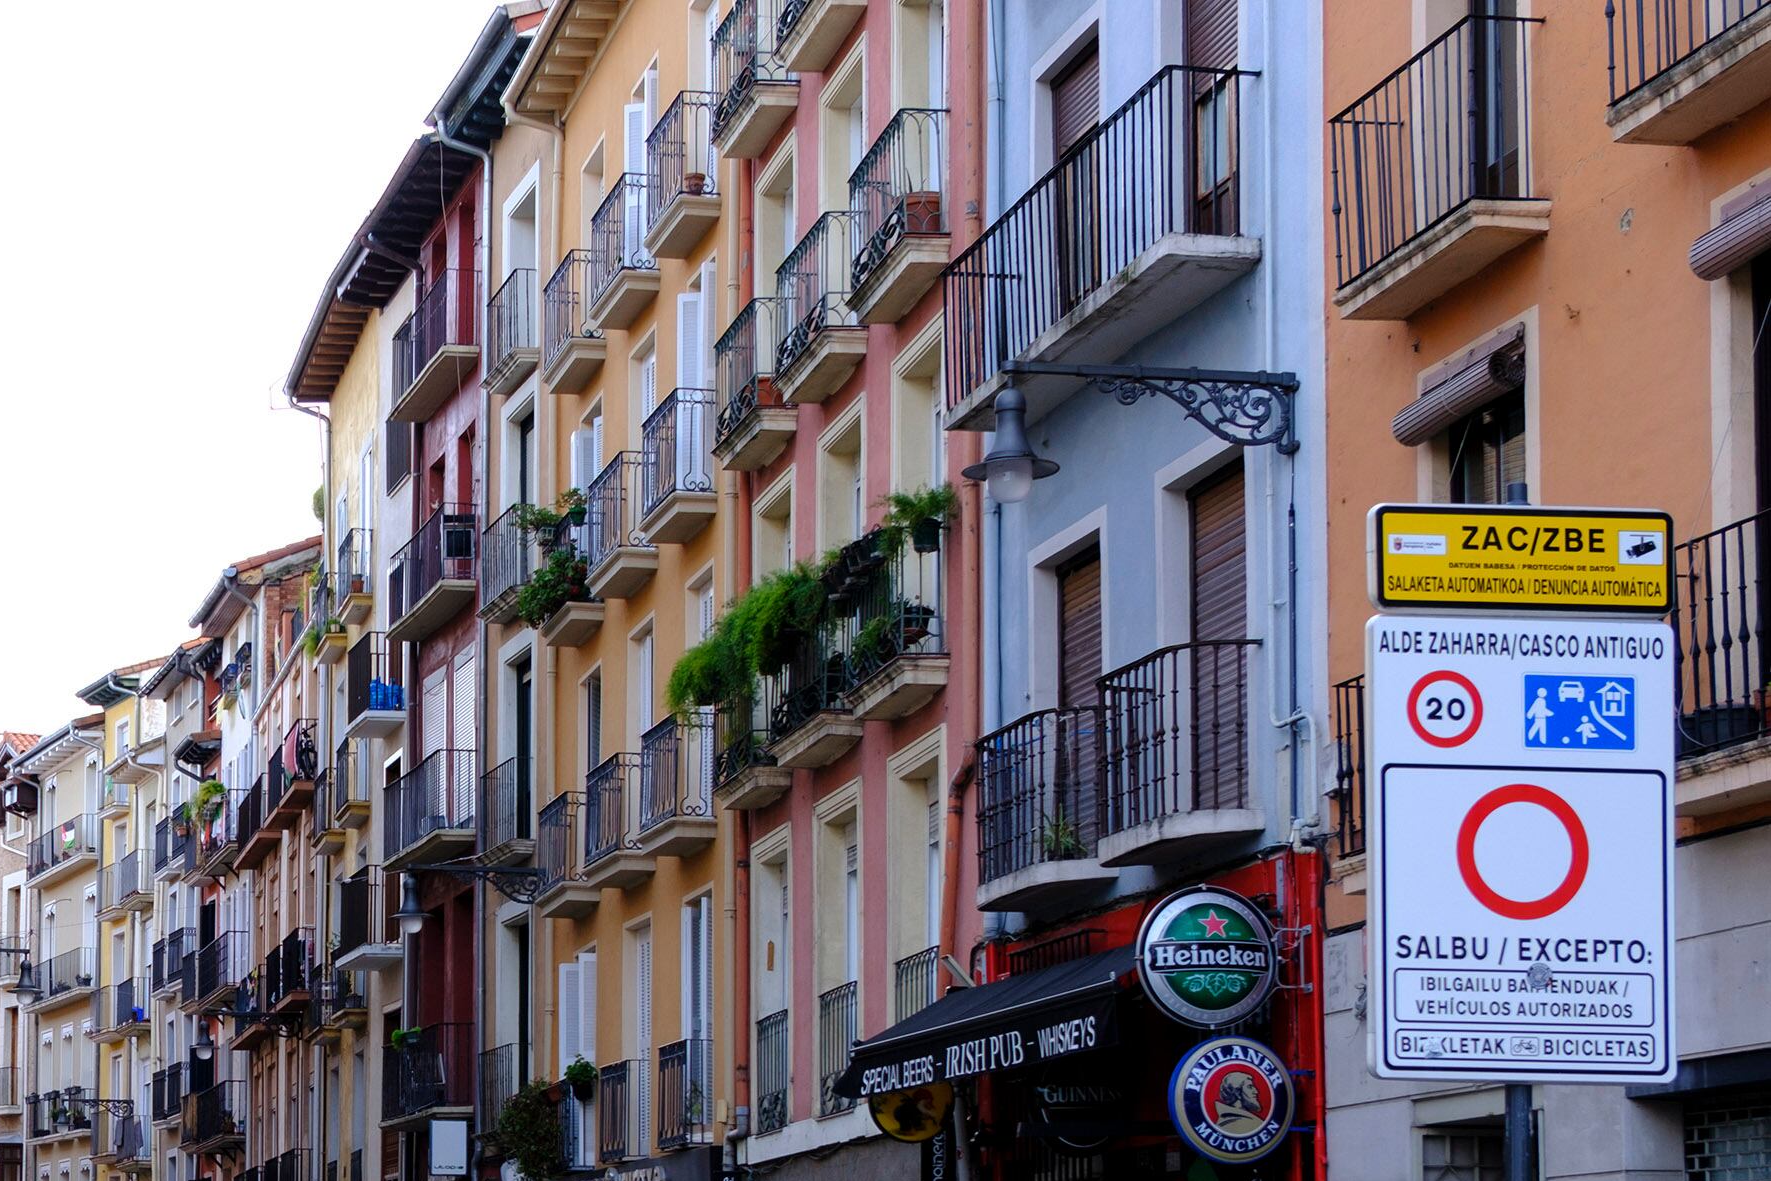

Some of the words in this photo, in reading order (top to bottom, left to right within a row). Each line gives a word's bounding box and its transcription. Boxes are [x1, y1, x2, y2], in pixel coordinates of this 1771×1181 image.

[1461, 525, 1605, 556] ZAC/ZBE
[1522, 563, 1574, 572] PROTECCIÓN
[1388, 575, 1445, 593] SALAKETA
[1448, 577, 1525, 595] AUTOMATIKOA
[1533, 579, 1589, 596] DENUNCIA
[1590, 577, 1662, 598] AUTOMÁTICA
[1379, 631, 1422, 654] ALDE
[1428, 632, 1579, 660] ZAHARRA/CASCO
[1584, 635, 1665, 660] ANTIGUO
[1426, 697, 1465, 721] 20
[1154, 945, 1267, 968] Heineken
[1396, 934, 1489, 960] SALBU
[1518, 938, 1653, 964] EXCEPTO:
[1420, 976, 1502, 993] IBILGAILU
[1416, 997, 1511, 1016] VEHÍCULOS
[1517, 1002, 1633, 1018] AUTORIZADOS
[860, 1063, 902, 1095] SPECIAL
[903, 1054, 934, 1088] BEERS
[945, 1038, 986, 1079] IRISH
[989, 1030, 1024, 1070] PUB
[1037, 1015, 1096, 1058] WHISKEYS
[1401, 1037, 1505, 1054] BIZKLETAK
[1543, 1039, 1649, 1057] BICICLETAS
[1185, 1045, 1283, 1093] PAULANER
[1194, 1120, 1280, 1152] MÜNCHEN
